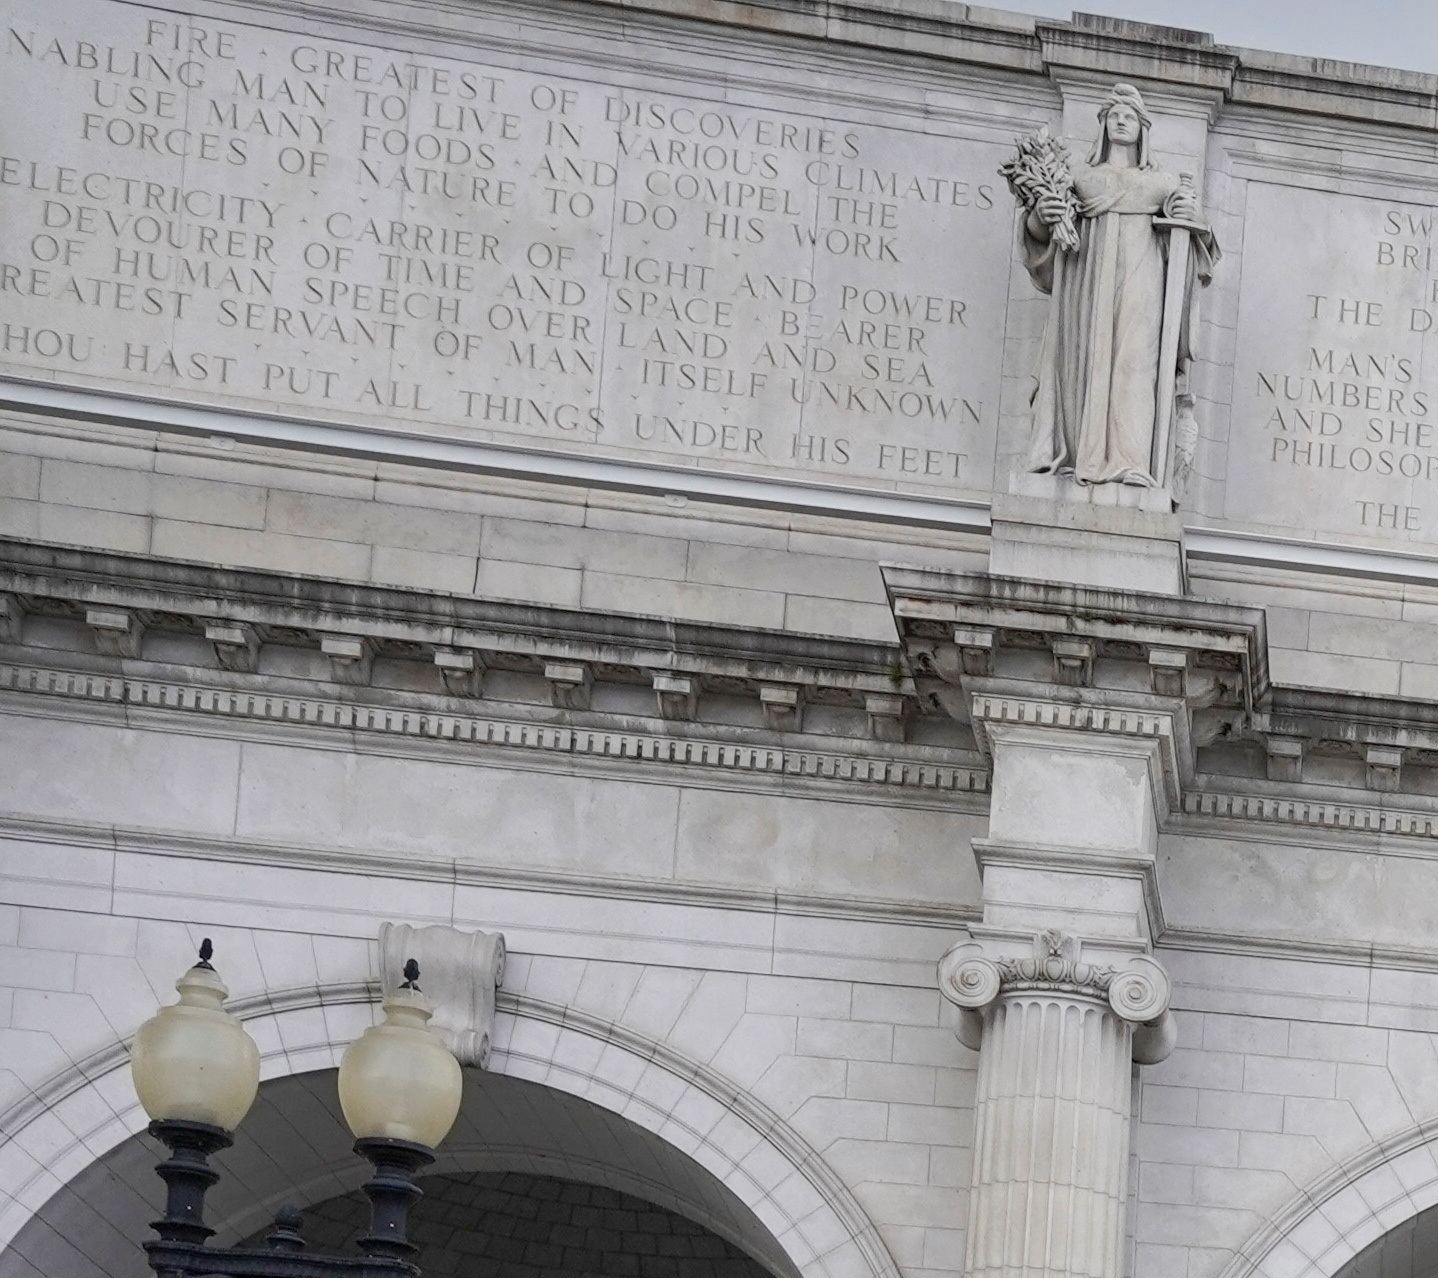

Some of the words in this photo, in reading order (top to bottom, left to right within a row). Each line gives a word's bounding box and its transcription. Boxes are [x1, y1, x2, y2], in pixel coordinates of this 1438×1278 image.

[3, 27, 205, 89] NABLING
[232, 70, 328, 106] MAN
[354, 90, 407, 122] TO
[434, 103, 522, 141] LIVE
[545, 121, 583, 147] IN
[615, 130, 780, 181] VARIOUS
[804, 161, 995, 211] CLIMATES
[91, 79, 176, 118] USE
[207, 100, 335, 146] MANY
[361, 126, 497, 171] FOODS
[530, 155, 619, 188] AND
[645, 169, 803, 217] COMPEL
[828, 196, 899, 230] THE
[145, 19, 236, 59] FIRE
[291, 46, 506, 103] GREATEST
[530, 84, 580, 115] OF
[604, 96, 862, 160] DISCOVERIES
[1, 156, 287, 229] ELECTRICITY
[326, 211, 502, 265] CARRIER
[526, 242, 575, 271] OF
[602, 252, 715, 293] LIGHT
[732, 273, 818, 305] AND
[839, 284, 969, 327] POWER
[79, 113, 248, 166] FORCES
[278, 146, 329, 177] OF
[356, 158, 517, 207] NATURE
[543, 187, 595, 219] TO
[620, 200, 678, 231] DO
[704, 212, 766, 245] HIS
[793, 223, 902, 263] WORK
[30, 234, 86, 266] OF
[113, 247, 276, 296] HUMAN
[303, 277, 461, 325] SPEECH
[488, 304, 592, 344] OVER
[617, 323, 728, 359] LAND
[752, 342, 838, 374] AND
[861, 354, 936, 387] SEA
[41, 200, 278, 265] DEVOURER
[303, 243, 354, 274] OF
[378, 253, 475, 293] TIME
[500, 274, 585, 307] AND
[613, 290, 734, 328] SPACE
[779, 310, 926, 355] BEARER
[122, 342, 238, 384] HAST
[262, 363, 340, 399] PUT
[356, 380, 432, 412] ALL
[457, 388, 606, 433] THINGS
[634, 413, 769, 456] UNDER
[790, 433, 851, 466] HIS
[878, 444, 969, 479] FEET
[219, 299, 405, 350] SERVANT
[434, 331, 483, 361] OF
[504, 340, 596, 376] MAN
[641, 359, 769, 399] ITSELF
[790, 377, 984, 425] UNKNOWN
[1255, 371, 1429, 417] NUMBERS
[1264, 406, 1344, 436] AND
[1355, 499, 1422, 531] THE
